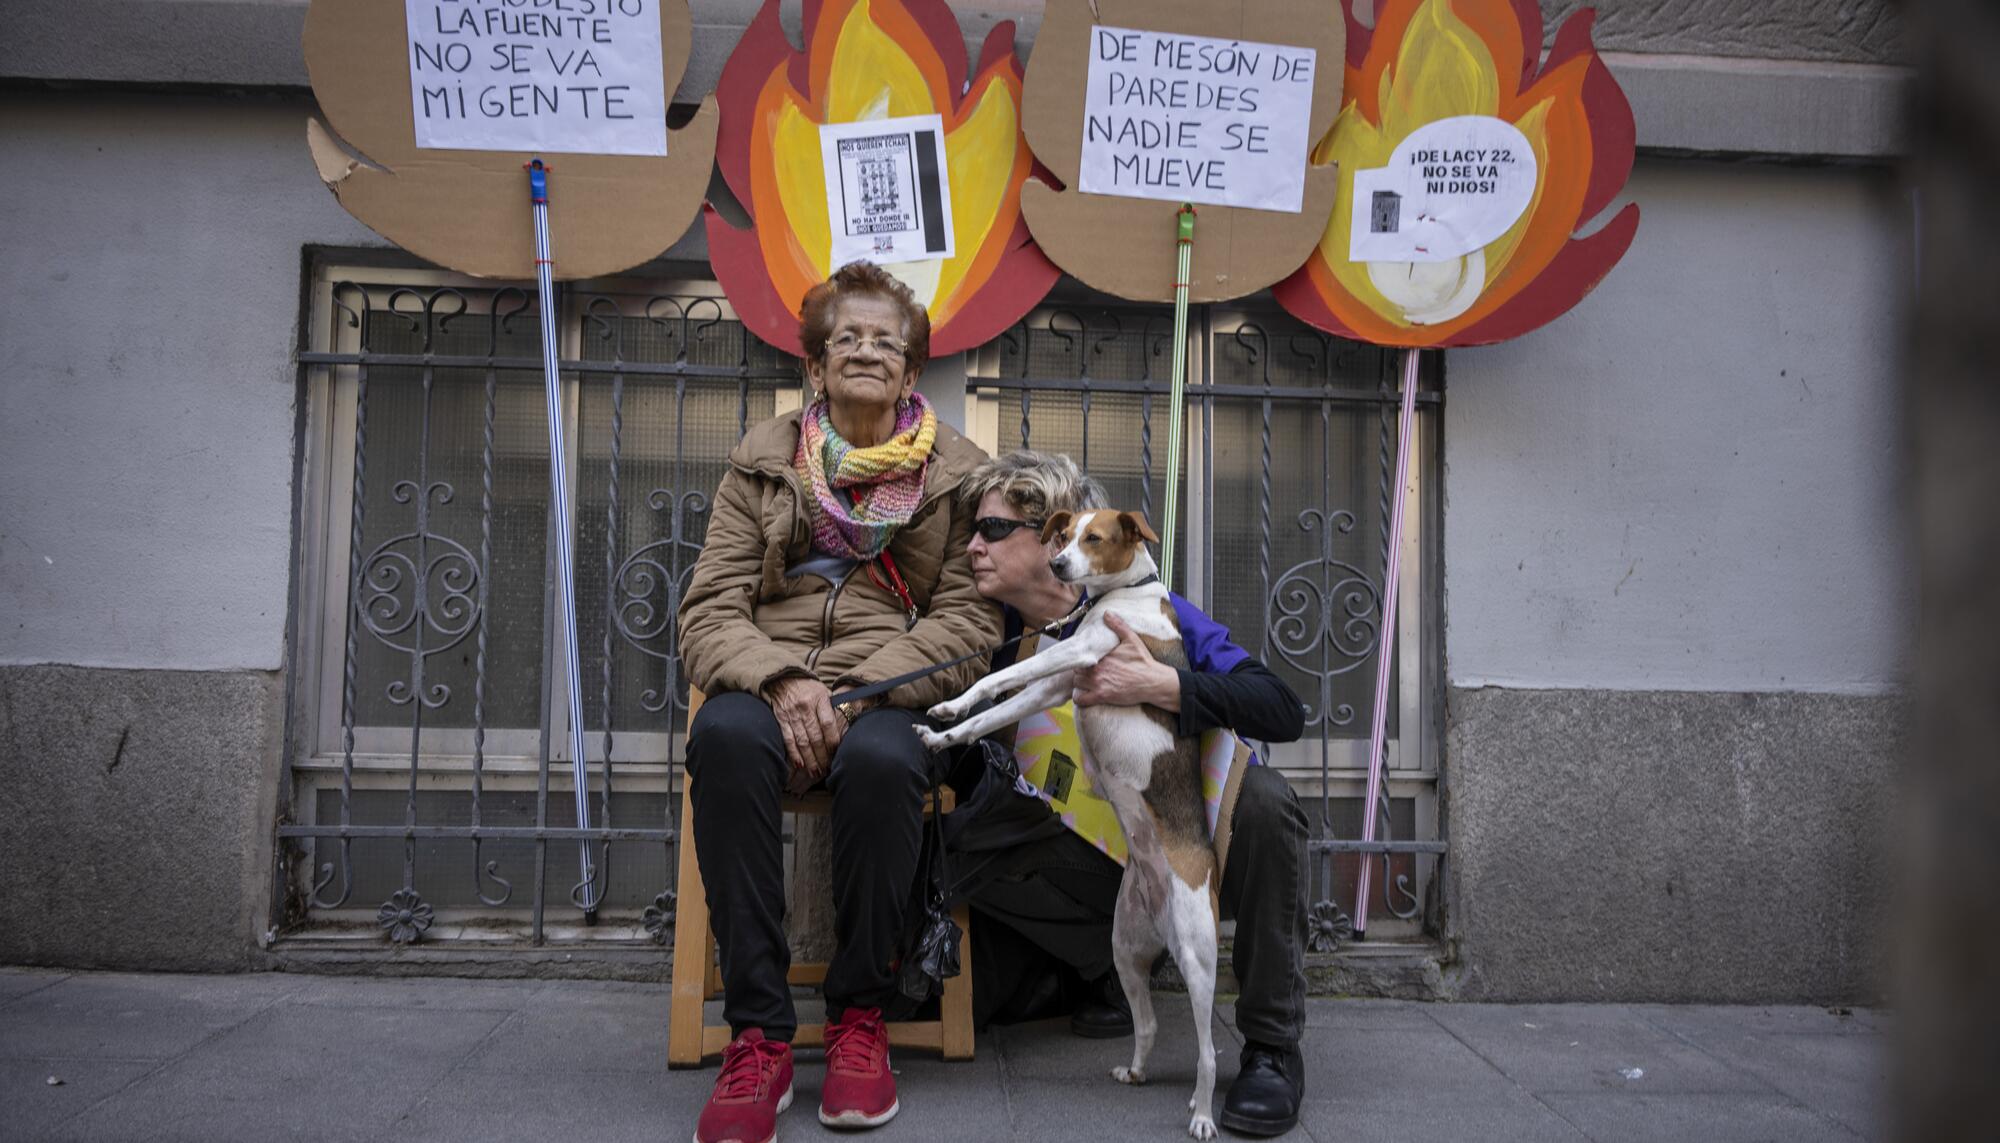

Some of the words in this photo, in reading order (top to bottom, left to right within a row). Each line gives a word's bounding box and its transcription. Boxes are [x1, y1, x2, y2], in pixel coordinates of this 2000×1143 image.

[414, 41, 472, 73] NO
[489, 43, 533, 73] SE
[547, 49, 602, 77] VA
[1099, 30, 1141, 62] DE
[1154, 39, 1260, 77] MESÓN
[1272, 54, 1311, 83] DE
[479, 84, 634, 119] GENTE
[1109, 72, 1259, 112] PAREDES
[1088, 114, 1202, 149] NADIE
[1220, 123, 1269, 153] SE
[1113, 154, 1226, 190] MUEVE
[1411, 150, 1439, 165] ¡DE
[1443, 150, 1487, 163] LACY
[1491, 149, 1516, 164] 22,
[1423, 165, 1448, 178] NO
[1451, 165, 1472, 178] SE
[1476, 165, 1499, 178] VA
[1427, 181, 1444, 194] NI
[1448, 181, 1496, 194] DIOS!
